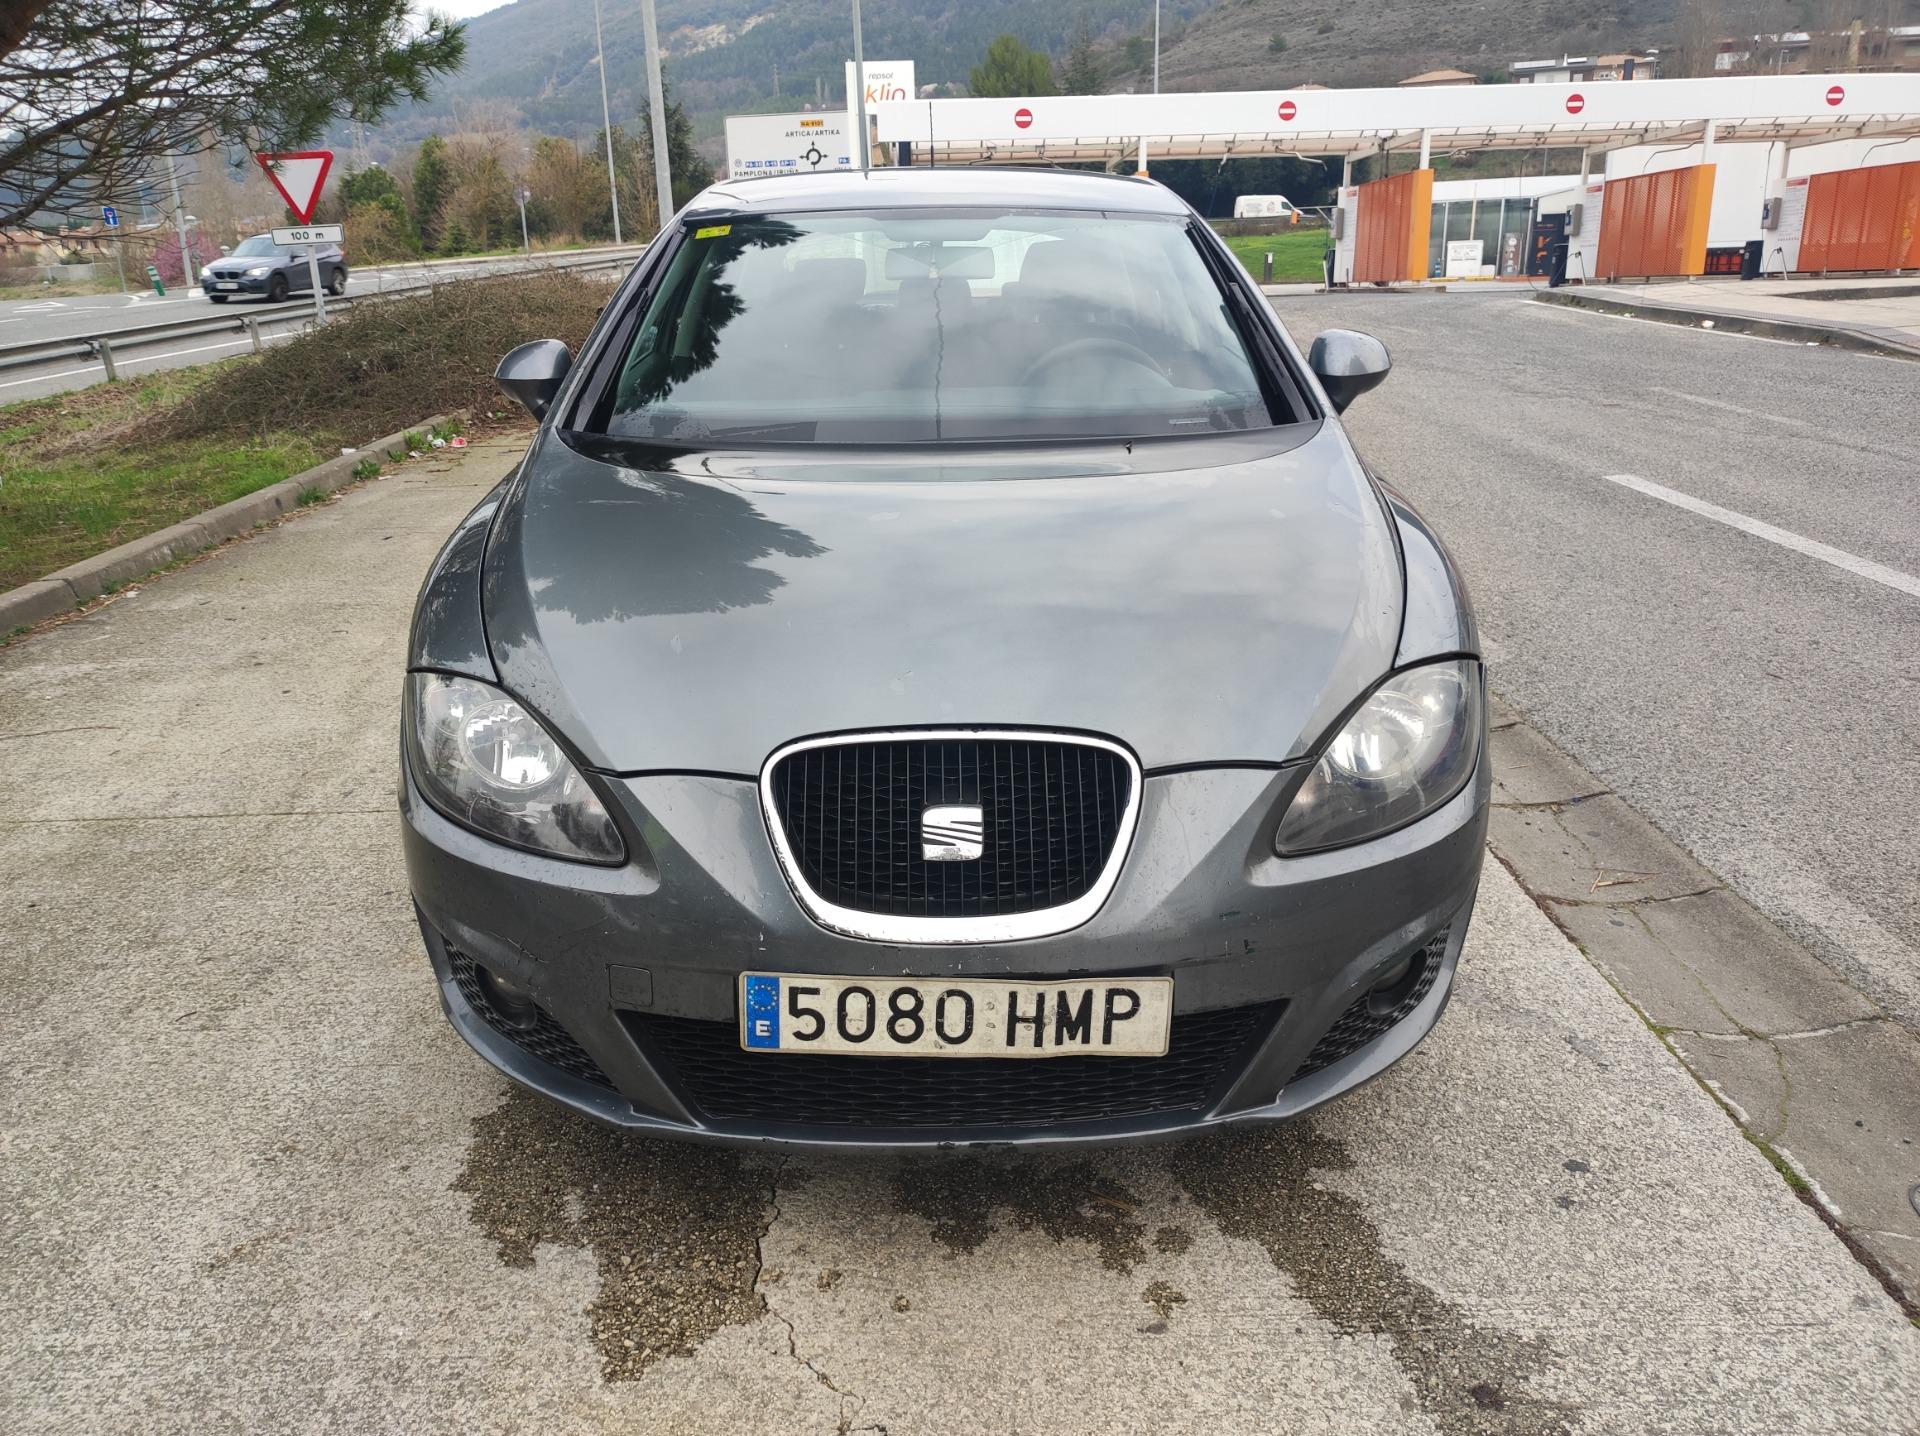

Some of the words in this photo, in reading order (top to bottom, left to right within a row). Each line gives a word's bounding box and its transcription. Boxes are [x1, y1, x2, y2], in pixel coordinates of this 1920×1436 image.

[869, 71, 894, 80] repsol
[865, 83, 906, 103] klin
[785, 129, 840, 137] ARTICA/ARTIKA
[290, 231, 310, 241] 100
[787, 985, 975, 1046] 5080
[1006, 987, 1142, 1048] HMP
[755, 1019, 771, 1037] E
